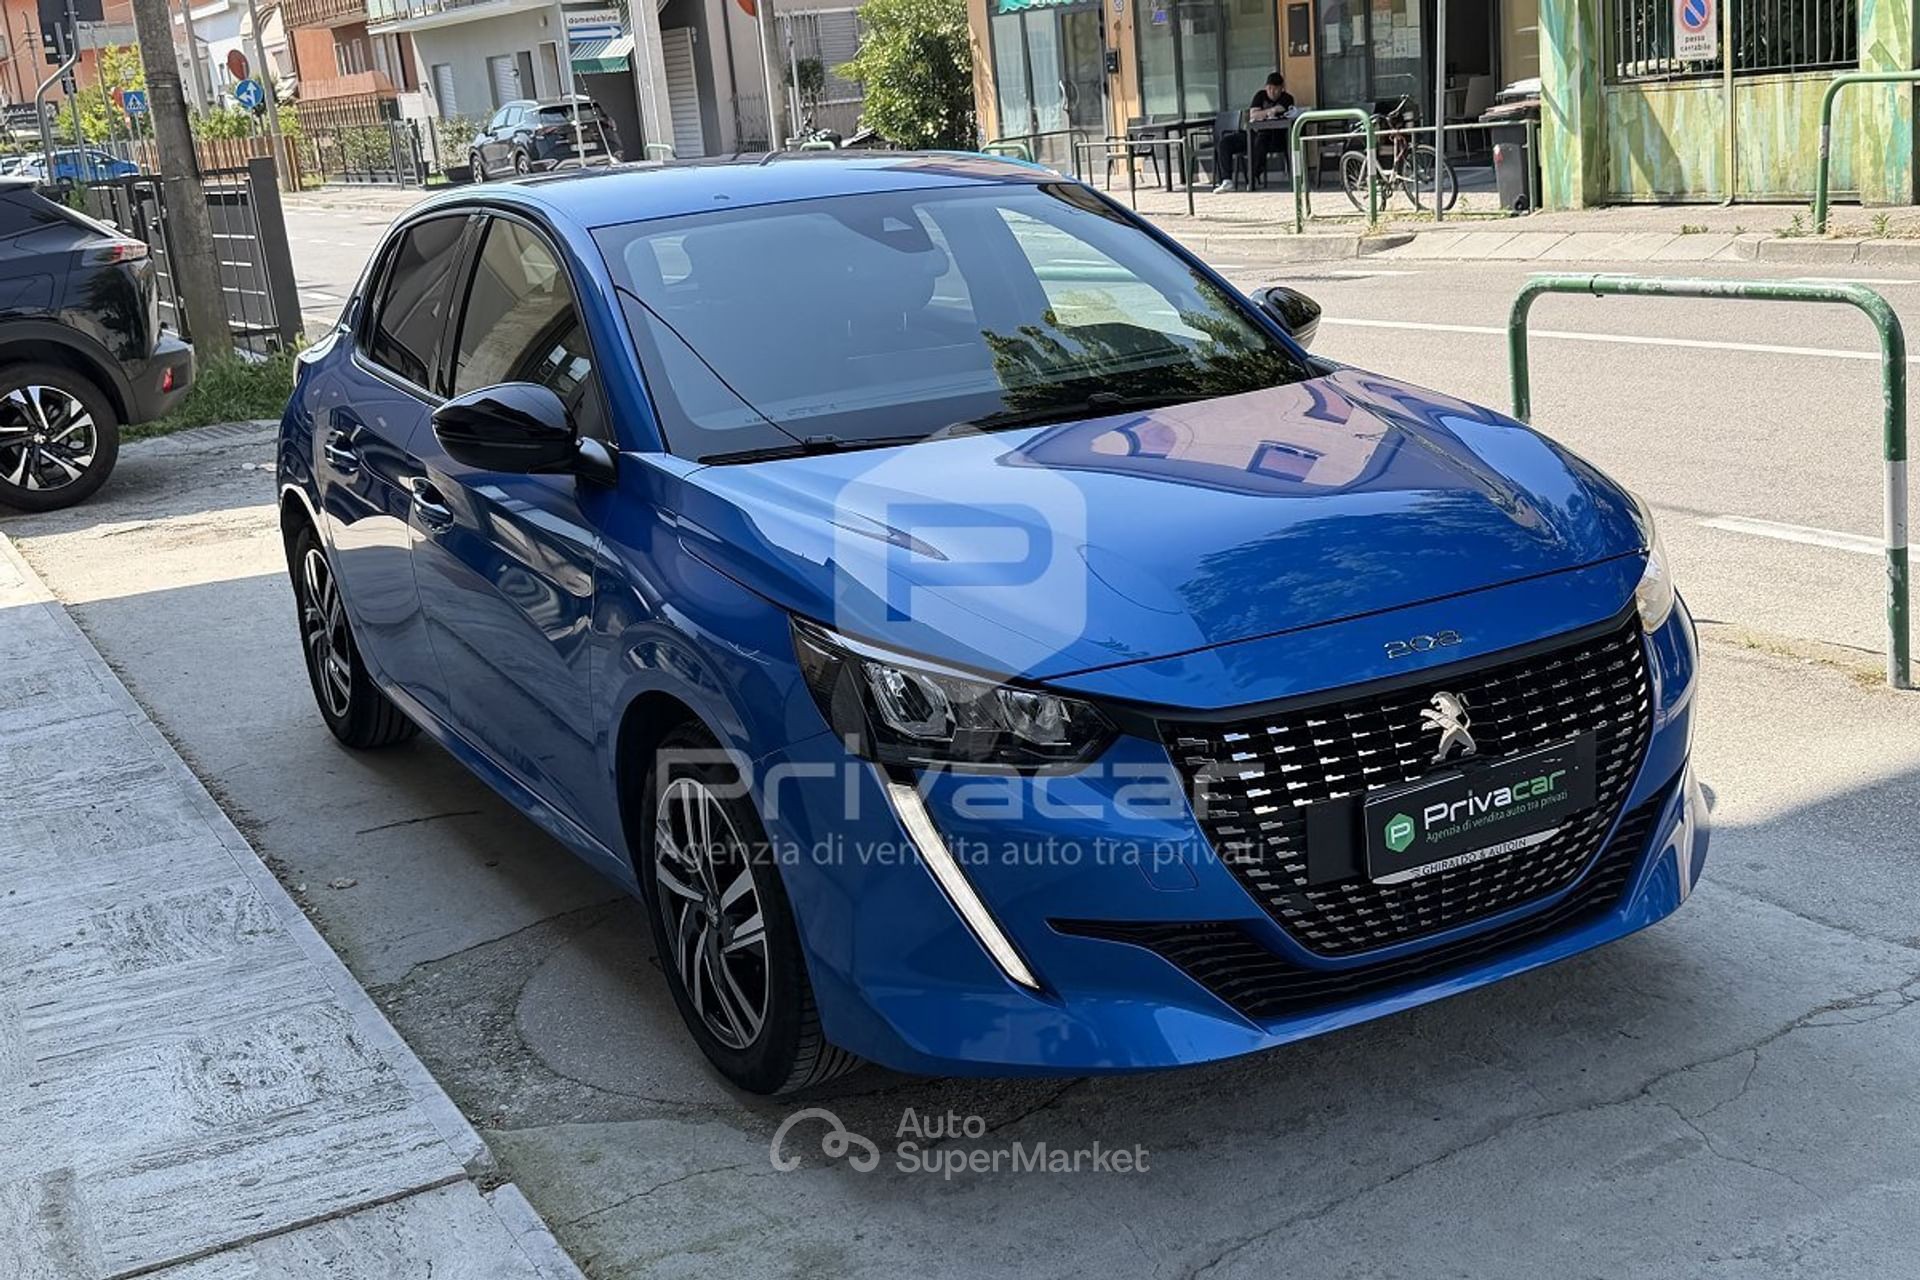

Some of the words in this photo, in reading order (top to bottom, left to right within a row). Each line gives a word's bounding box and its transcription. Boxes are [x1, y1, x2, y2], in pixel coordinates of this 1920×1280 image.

[1384, 630, 1463, 659] 208
[1424, 770, 1566, 830] Privacar
[1425, 825, 1461, 843] Agenzia
[1462, 819, 1472, 832] di
[1473, 810, 1505, 828] vendita
[1506, 804, 1526, 818] auto
[1527, 800, 1539, 811] tra
[1540, 791, 1568, 808] privati
